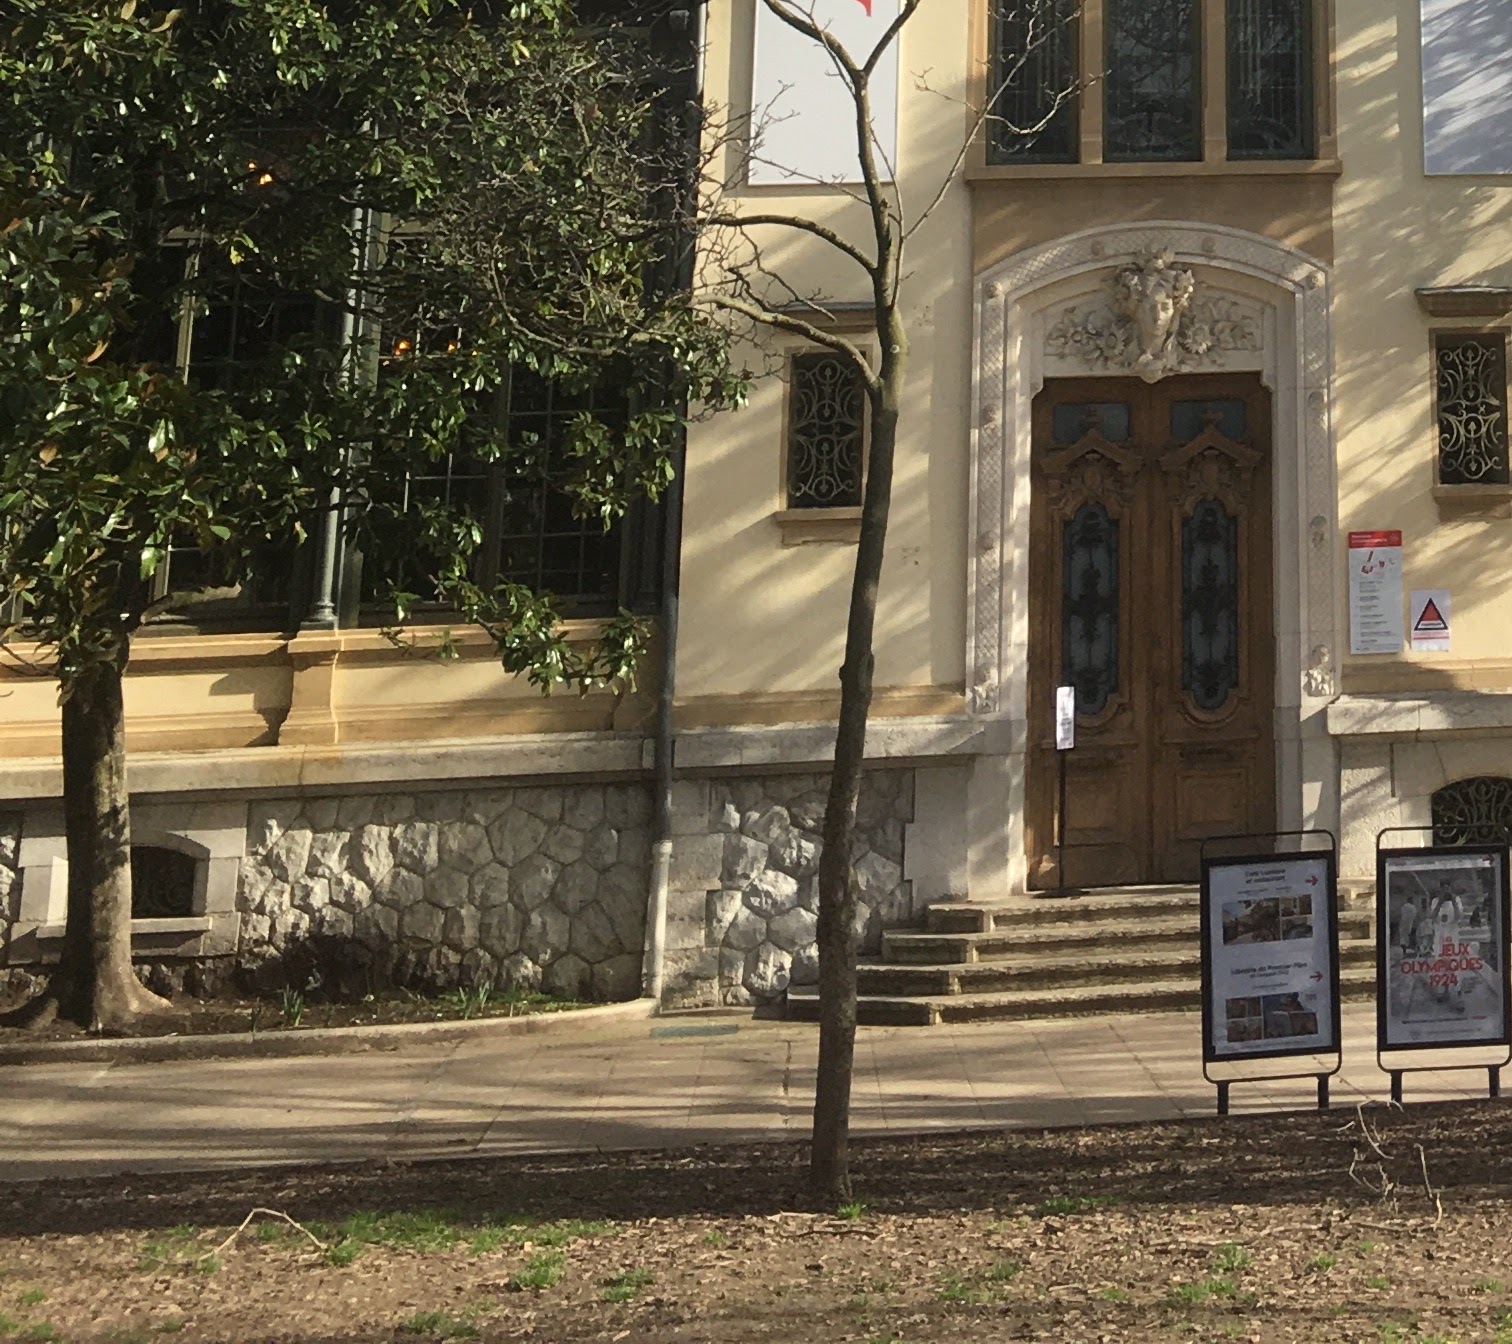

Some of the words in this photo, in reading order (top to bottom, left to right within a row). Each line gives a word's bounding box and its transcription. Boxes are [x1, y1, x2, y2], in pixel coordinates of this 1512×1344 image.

[1439, 942, 1470, 957] JEUX
[1400, 957, 1484, 974] OLYMPIQUES
[1429, 973, 1458, 988] 1924
